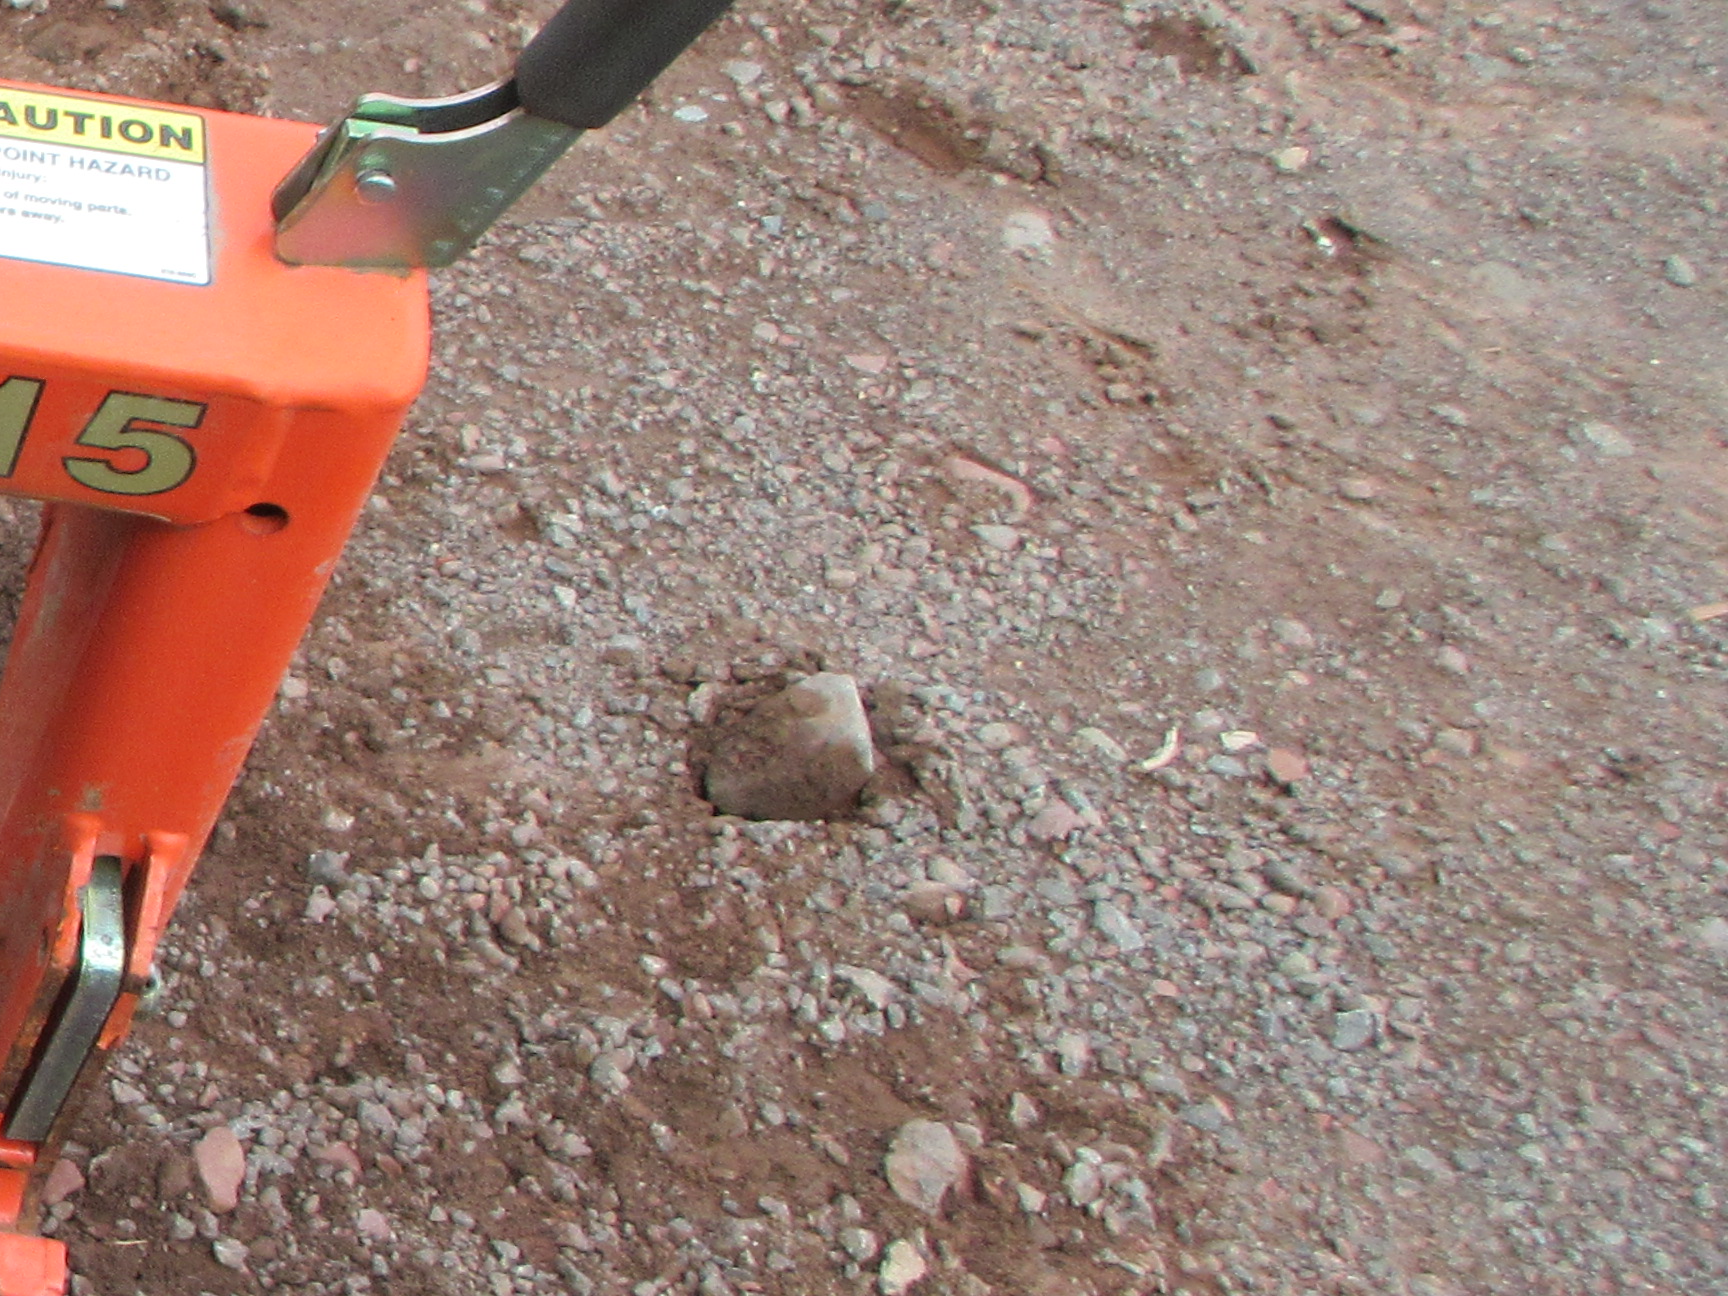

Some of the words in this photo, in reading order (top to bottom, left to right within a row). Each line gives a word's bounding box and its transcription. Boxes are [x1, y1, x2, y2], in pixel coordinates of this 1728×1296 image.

[69, 155, 171, 182] HAZARD
[3, 189, 19, 200] of
[24, 192, 83, 211] moving
[87, 202, 132, 216] parts.
[21, 208, 65, 224] away.
